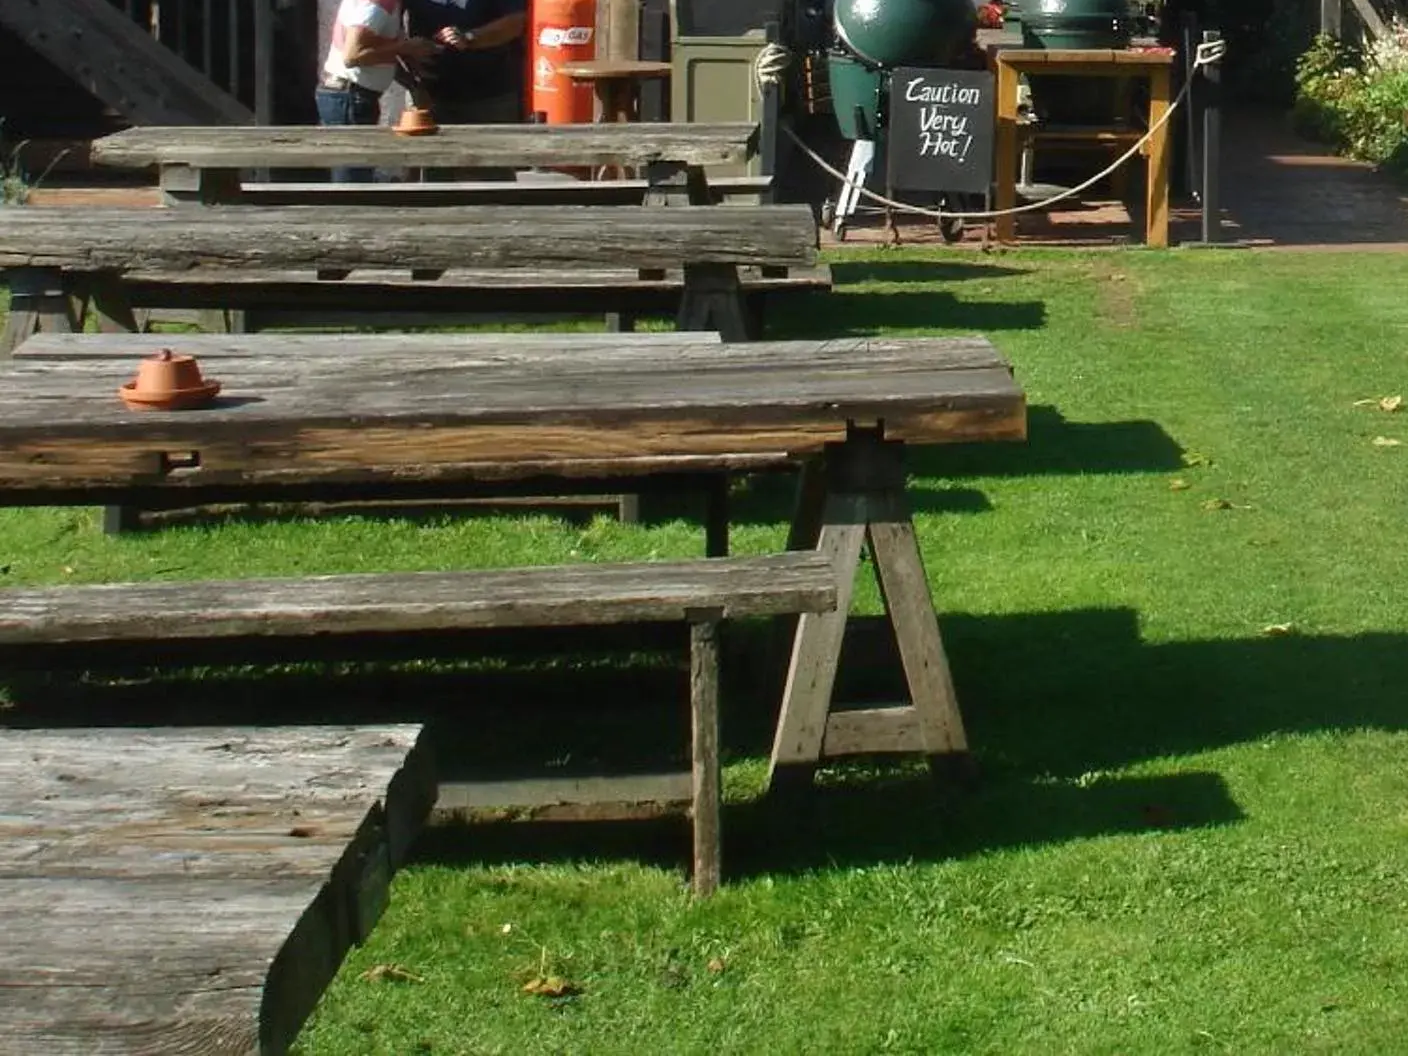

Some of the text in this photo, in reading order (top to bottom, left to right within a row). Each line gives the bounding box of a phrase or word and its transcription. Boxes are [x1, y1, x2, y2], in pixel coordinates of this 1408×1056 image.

[906, 77, 980, 104] Caution
[920, 107, 967, 136] Very
[919, 131, 973, 162] Hot!
